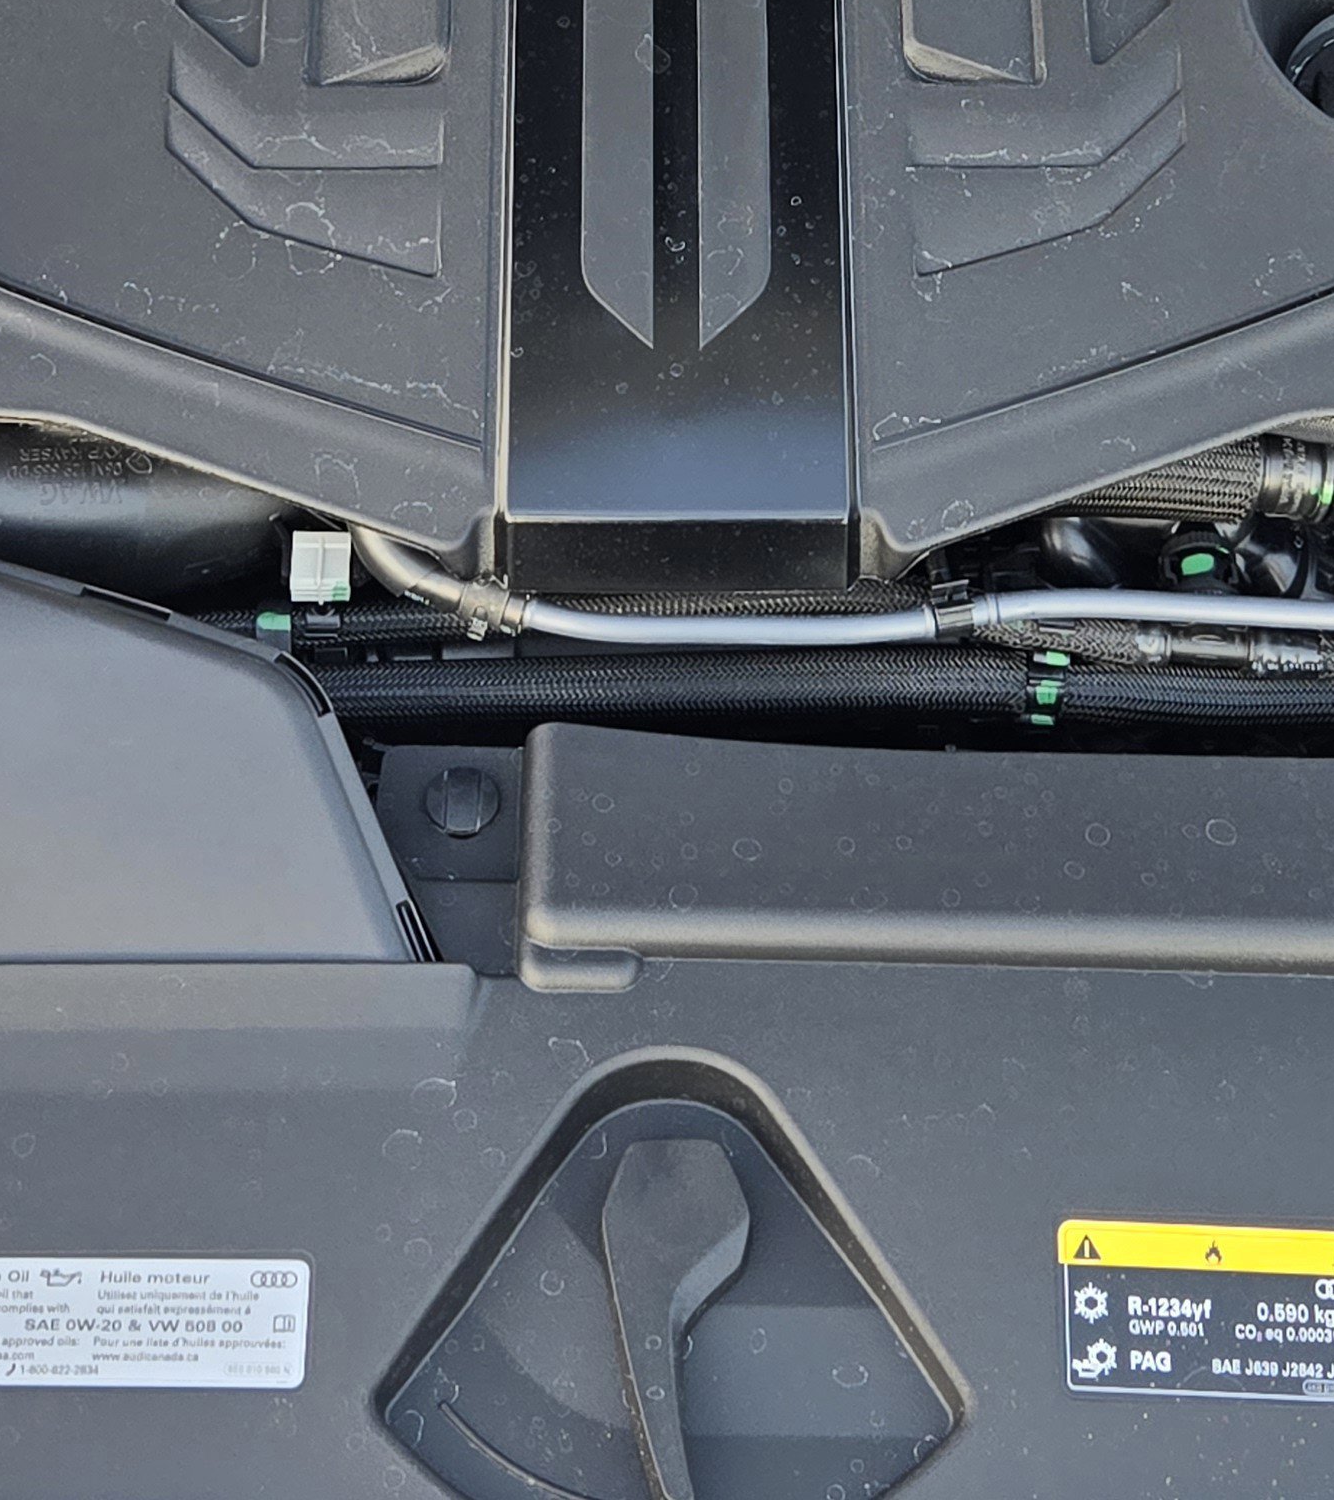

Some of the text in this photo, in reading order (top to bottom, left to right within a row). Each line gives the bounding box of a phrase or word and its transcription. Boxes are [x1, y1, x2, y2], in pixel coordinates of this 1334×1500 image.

[19, 446, 83, 461] KAYSER
[8, 1270, 29, 1282] Oil
[100, 1271, 210, 1284] Huile moteur
[12, 1290, 33, 1299] that
[97, 1291, 259, 1302] Utilisez uniquement de l'huile
[47, 1303, 69, 1313] with
[97, 1306, 115, 1316] qui
[164, 1306, 242, 1317] expressément
[1128, 1296, 1212, 1322] R-1234yf
[24, 1319, 60, 1331] SAE
[66, 1319, 122, 1332] 0W-20
[128, 1320, 141, 1331] &
[149, 1319, 180, 1332] VW
[221, 1320, 243, 1333] 00
[1129, 1320, 1164, 1335] GWP
[2, 1336, 54, 1347] approved
[57, 1337, 80, 1346] oils:
[1266, 1330, 1283, 1343] eq
[93, 1337, 285, 1349] Pour une liste d'huiles approuvées:
[92, 1352, 199, 1361] www.audicanada.ca
[1130, 1351, 1171, 1372] PAG
[1212, 1358, 1241, 1375] SAE
